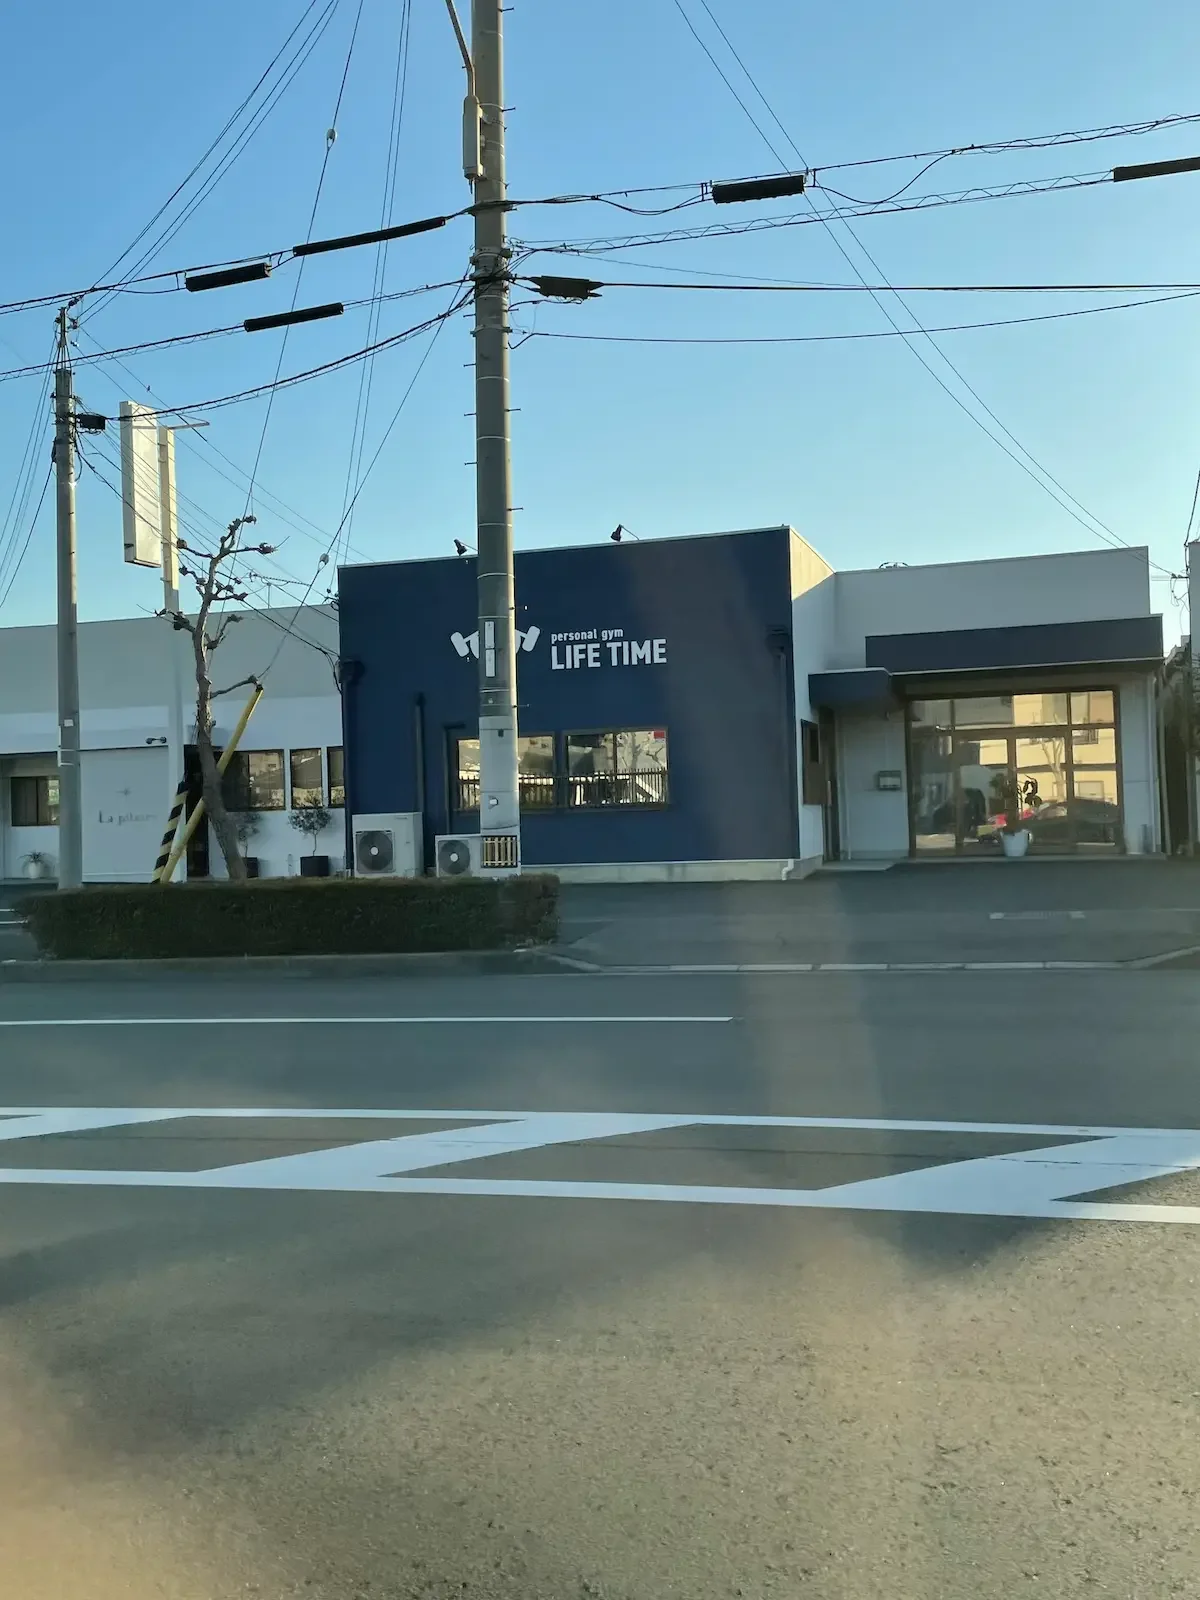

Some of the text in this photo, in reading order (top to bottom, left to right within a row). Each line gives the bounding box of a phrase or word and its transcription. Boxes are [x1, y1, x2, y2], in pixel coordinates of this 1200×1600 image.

[551, 628, 624, 644] personal gym
[551, 638, 667, 670] LIFE TIME
